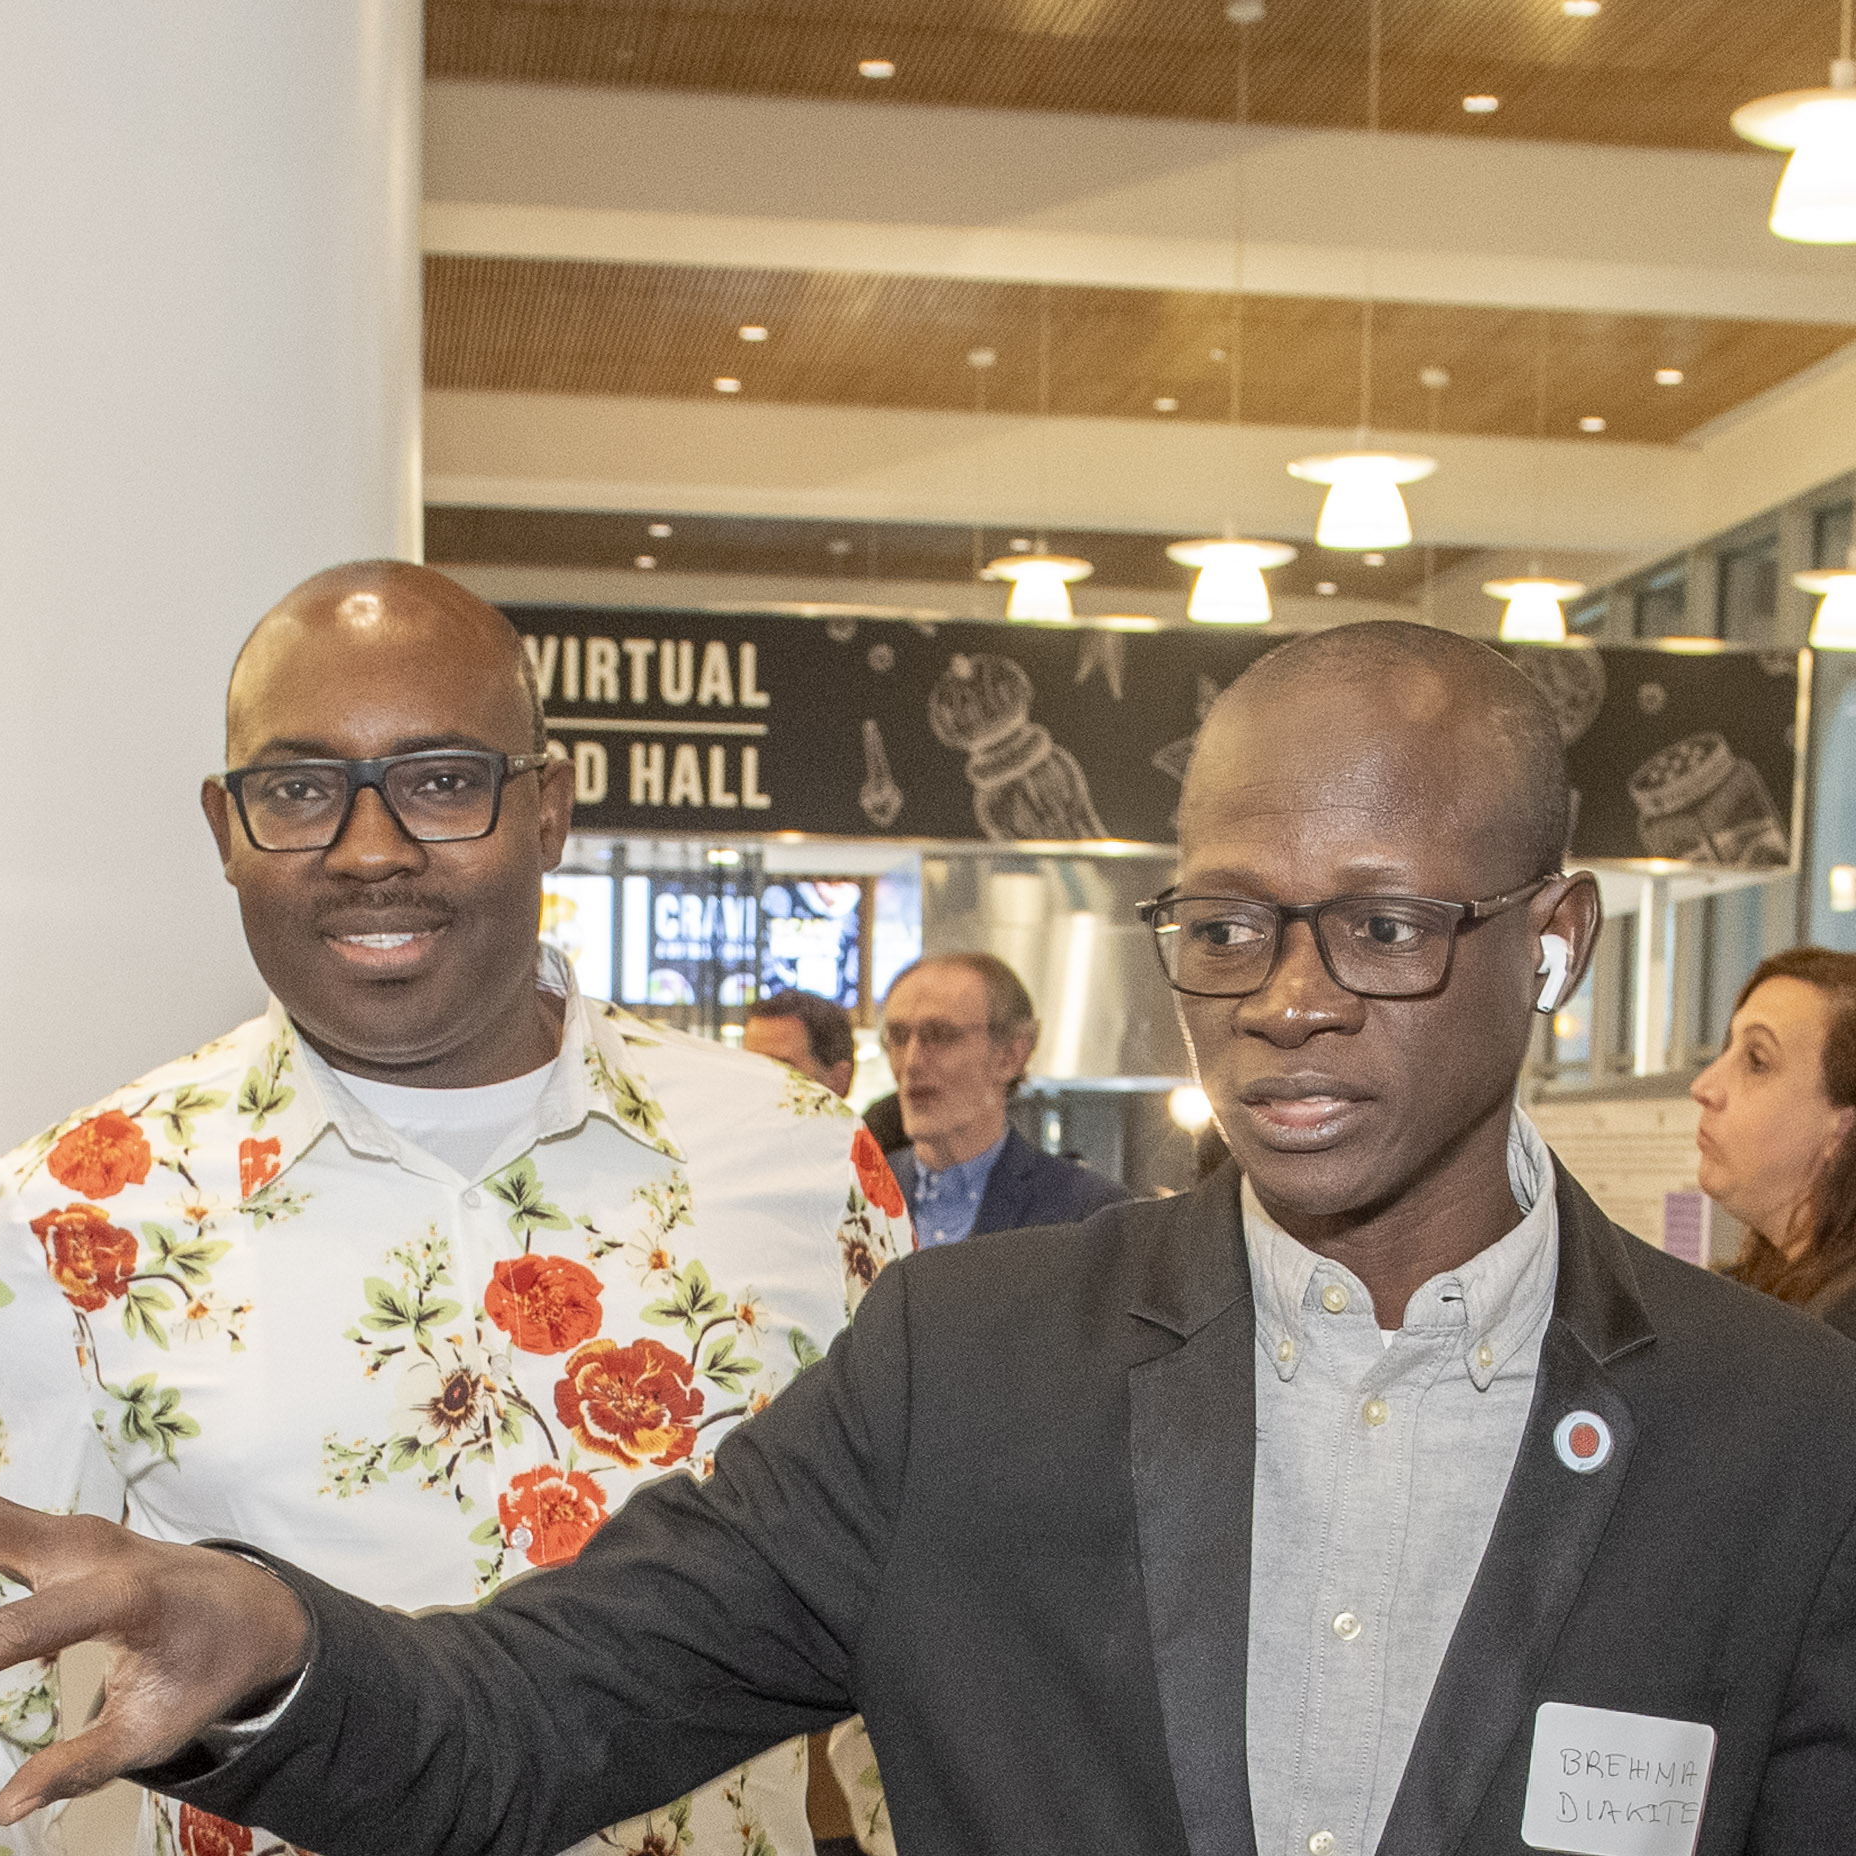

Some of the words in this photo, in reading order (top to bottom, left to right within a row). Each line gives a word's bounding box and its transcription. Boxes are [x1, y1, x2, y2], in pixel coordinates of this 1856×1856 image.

[523, 634, 771, 709] VIRTUAL
[629, 742, 772, 810] HALL
[1560, 1748, 1699, 1788] BREHIMA
[1556, 1790, 1699, 1825] DIAKITE
